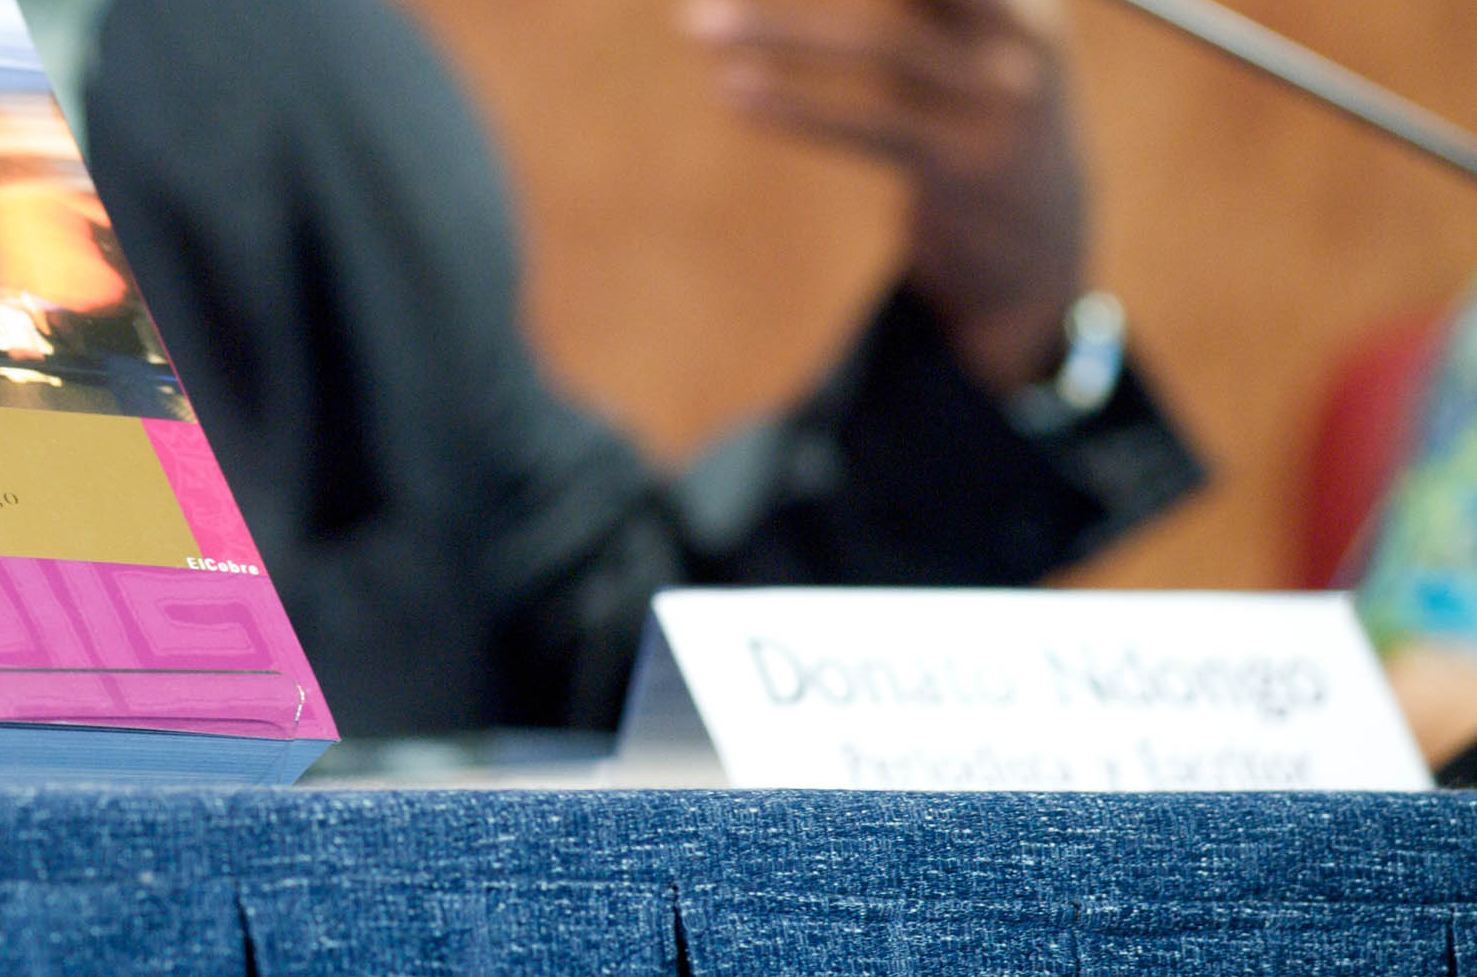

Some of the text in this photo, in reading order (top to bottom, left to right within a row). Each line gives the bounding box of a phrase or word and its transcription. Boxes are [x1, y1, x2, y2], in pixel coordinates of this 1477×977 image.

[185, 556, 260, 577] ElCobre
[748, 636, 1332, 724] Donato Ndongo
